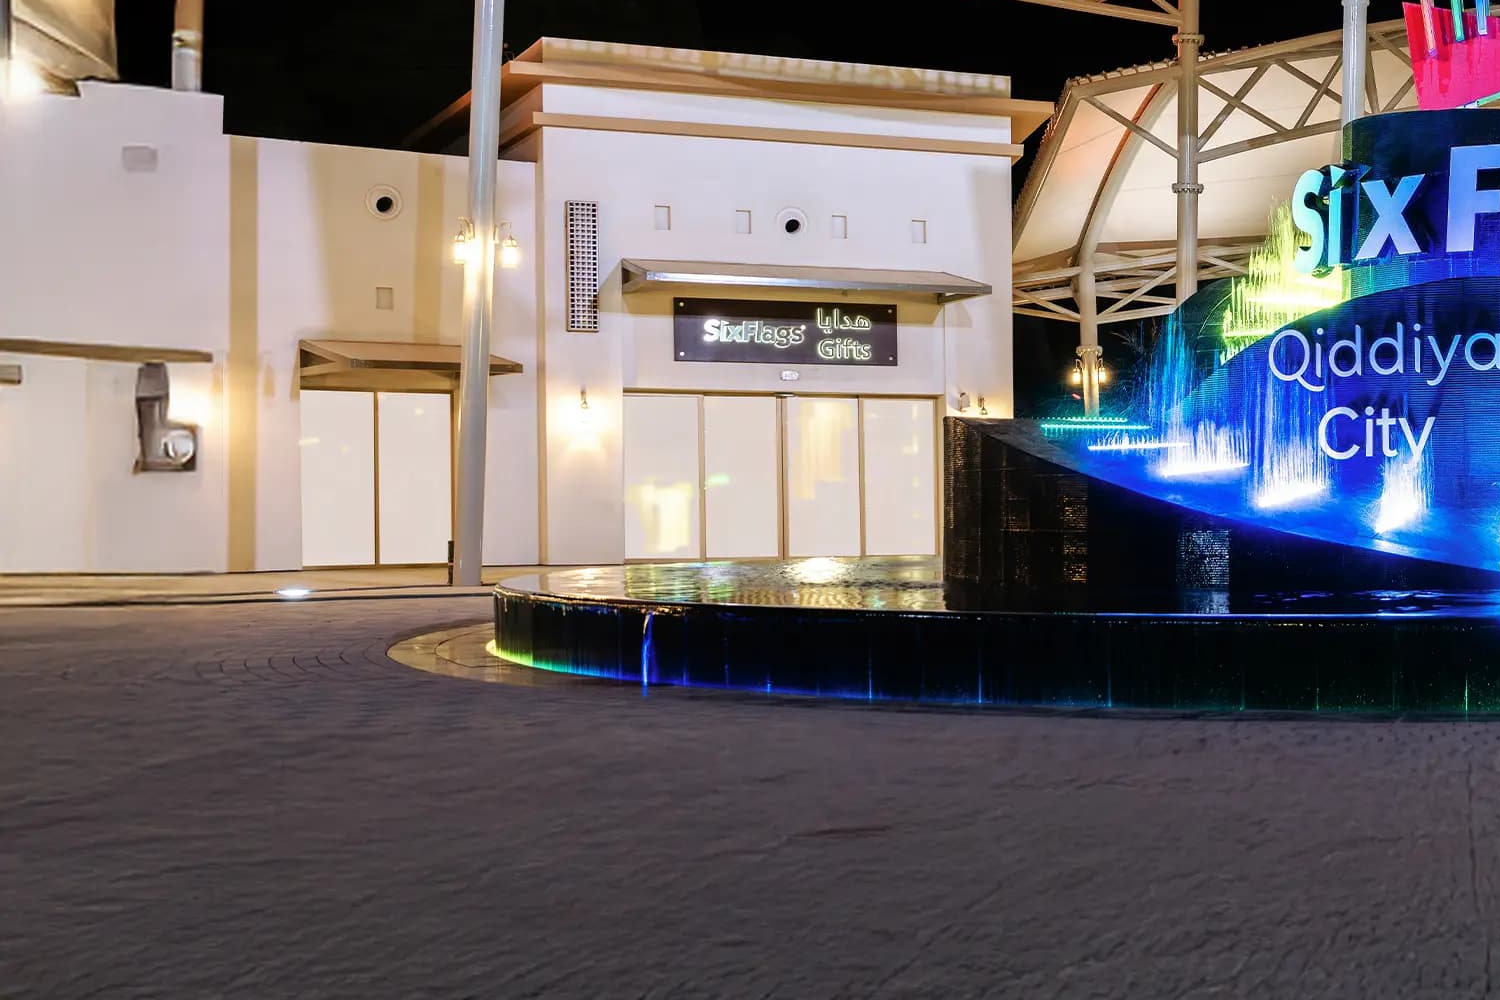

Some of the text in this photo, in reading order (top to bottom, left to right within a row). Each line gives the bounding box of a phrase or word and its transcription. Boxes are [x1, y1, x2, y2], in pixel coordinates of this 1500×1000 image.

[816, 307, 872, 334] هدايا
[816, 338, 872, 360] Gifts
[1318, 406, 1436, 464] City
